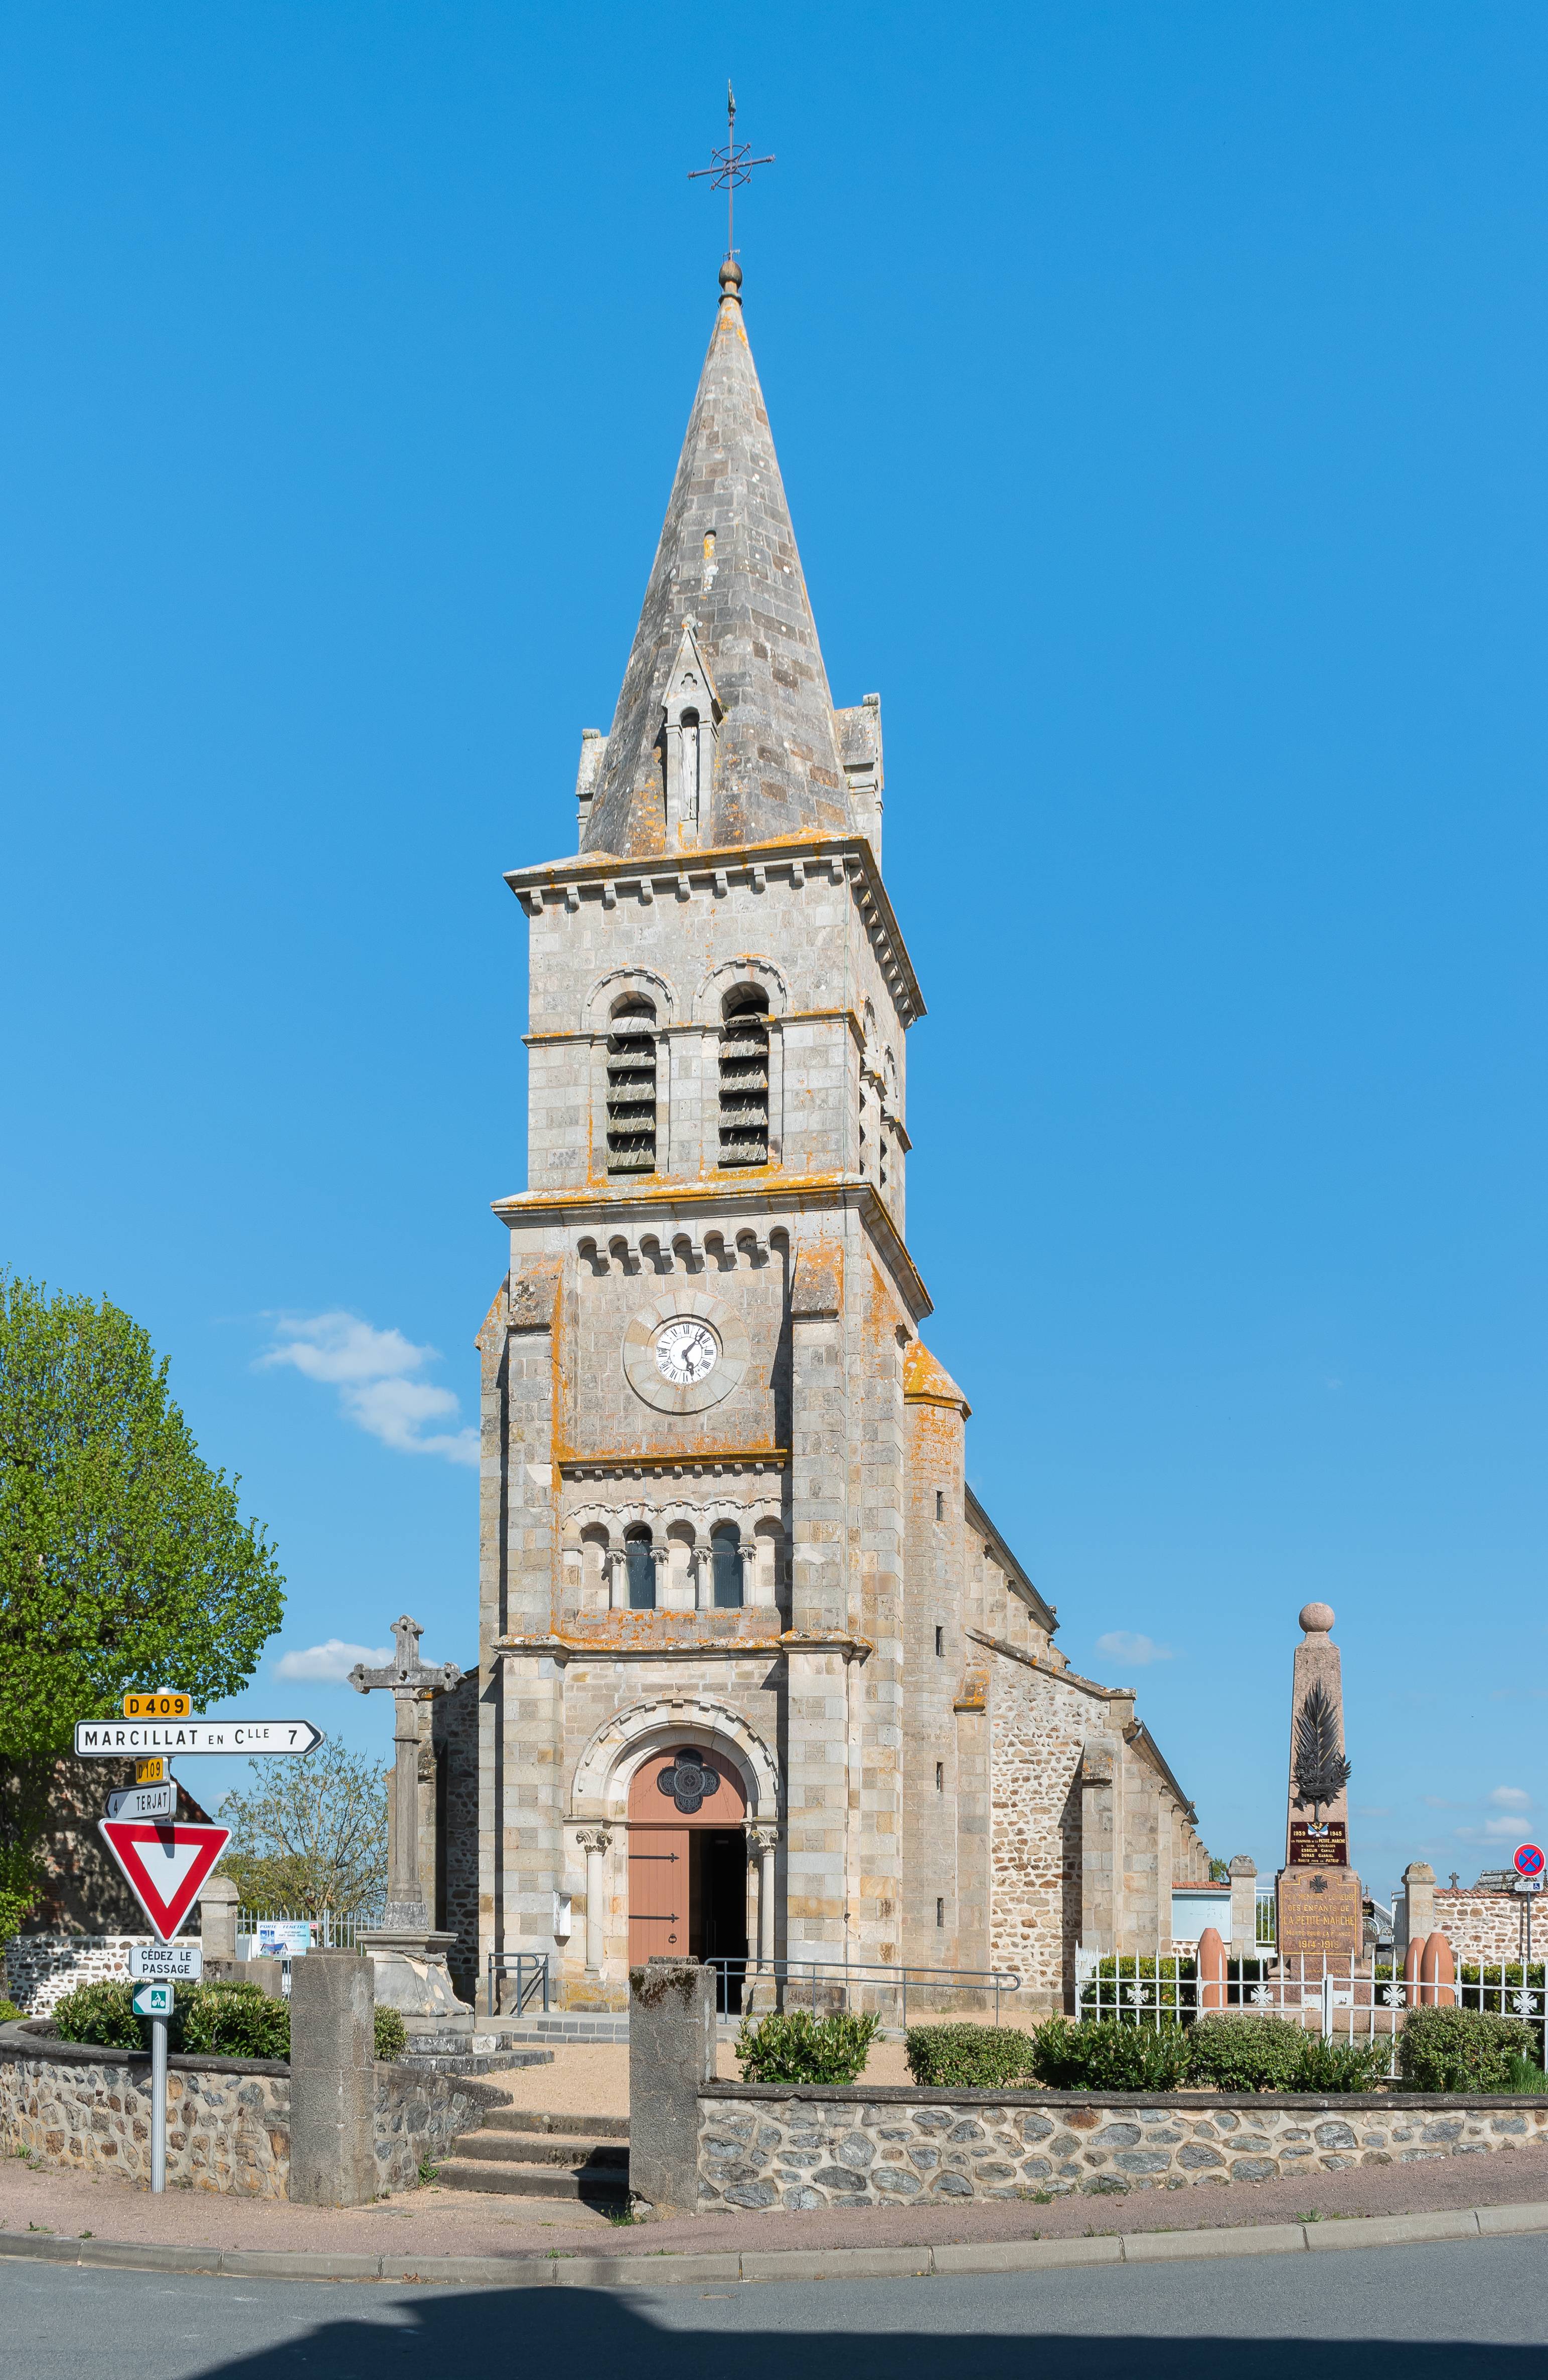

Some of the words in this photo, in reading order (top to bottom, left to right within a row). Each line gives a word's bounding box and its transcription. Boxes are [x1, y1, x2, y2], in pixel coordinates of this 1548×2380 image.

[130, 1699, 139, 1713] D
[146, 1698, 184, 1713] 409
[85, 1730, 198, 1746] MARCILLAT
[209, 1735, 223, 1744] EN
[288, 1730, 297, 1744] 7
[139, 1765, 143, 1779] D
[145, 1761, 161, 1778] 109
[113, 1799, 118, 1814] 4
[136, 1792, 167, 1811] TERJAT
[1283, 1916, 1294, 1925] LA
[141, 1949, 173, 1961] CÉDEZ
[180, 1952, 191, 1961] LE
[142, 1964, 190, 1974] PASSAGE
